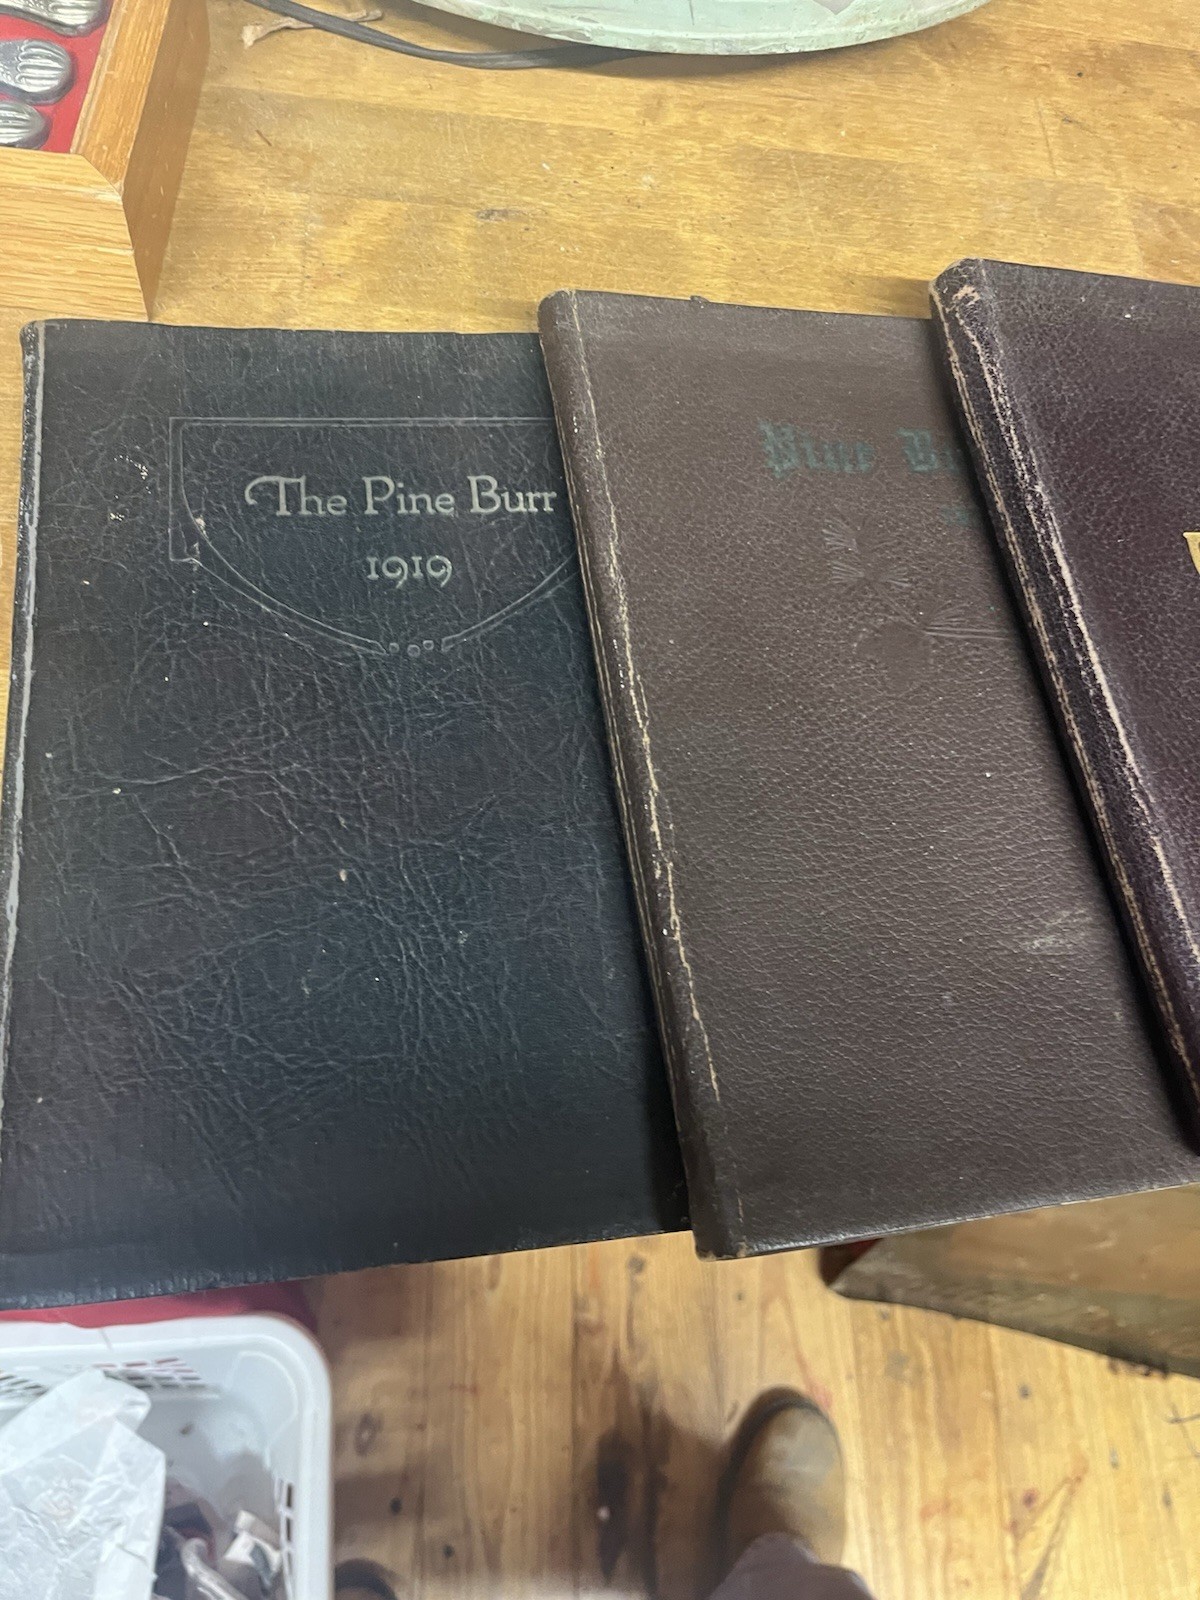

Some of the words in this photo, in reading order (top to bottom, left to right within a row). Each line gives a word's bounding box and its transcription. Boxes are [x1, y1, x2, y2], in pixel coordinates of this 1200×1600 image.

[244, 474, 348, 516] The
[362, 475, 455, 515] Pine
[467, 473, 557, 514] Burr
[366, 555, 453, 588] 1919
